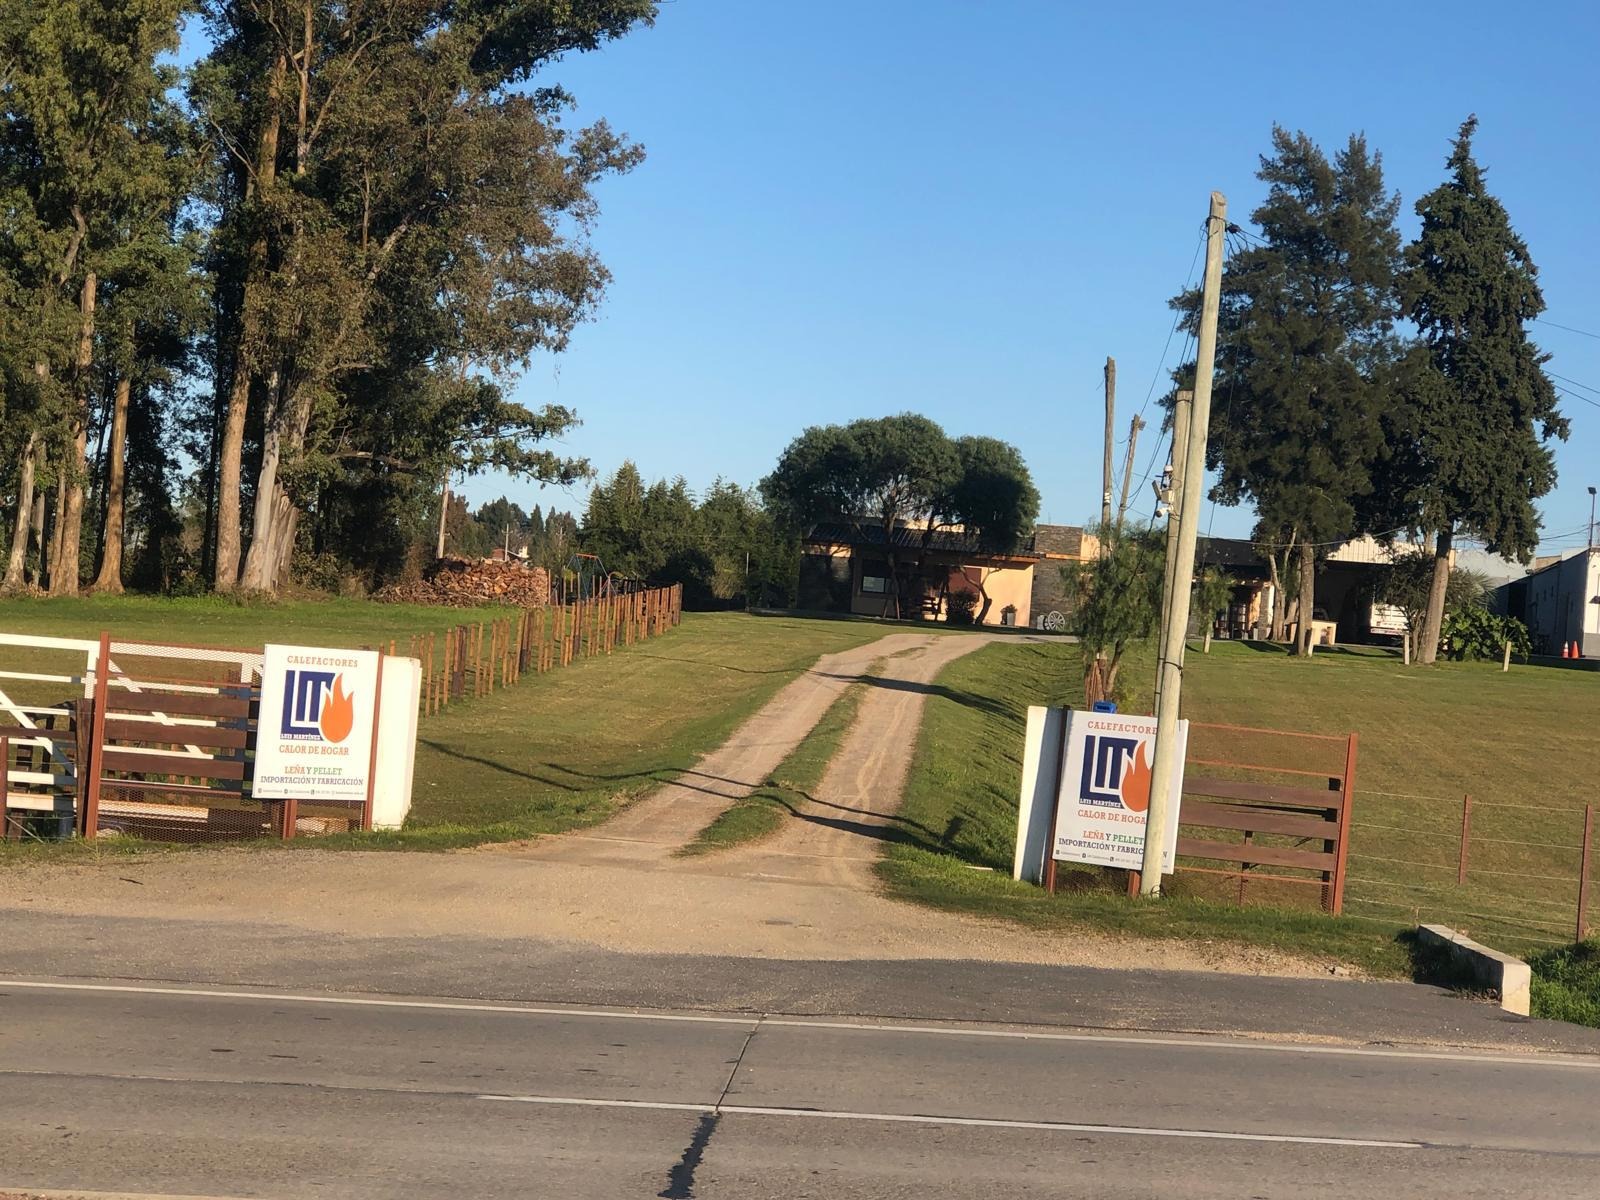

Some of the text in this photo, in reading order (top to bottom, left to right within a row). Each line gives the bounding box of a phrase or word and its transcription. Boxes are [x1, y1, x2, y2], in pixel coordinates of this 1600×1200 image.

[287, 656, 358, 667] CALEFACTORES
[1087, 721, 1158, 735] CALEFACTORE
[279, 744, 350, 756] CALOR DE HOGAR
[284, 764, 343, 776] LEÑA Y PELLET
[260, 775, 310, 785] IMPORTACIÓN
[317, 777, 364, 786] FABRICACIÓN
[1078, 809, 1147, 825] CALOR DE HOGA
[1083, 829, 1145, 846] LEÑA Y PELLET
[1058, 838, 1109, 851] IMPORTACIÓN
[1110, 844, 1116, 852] Y
